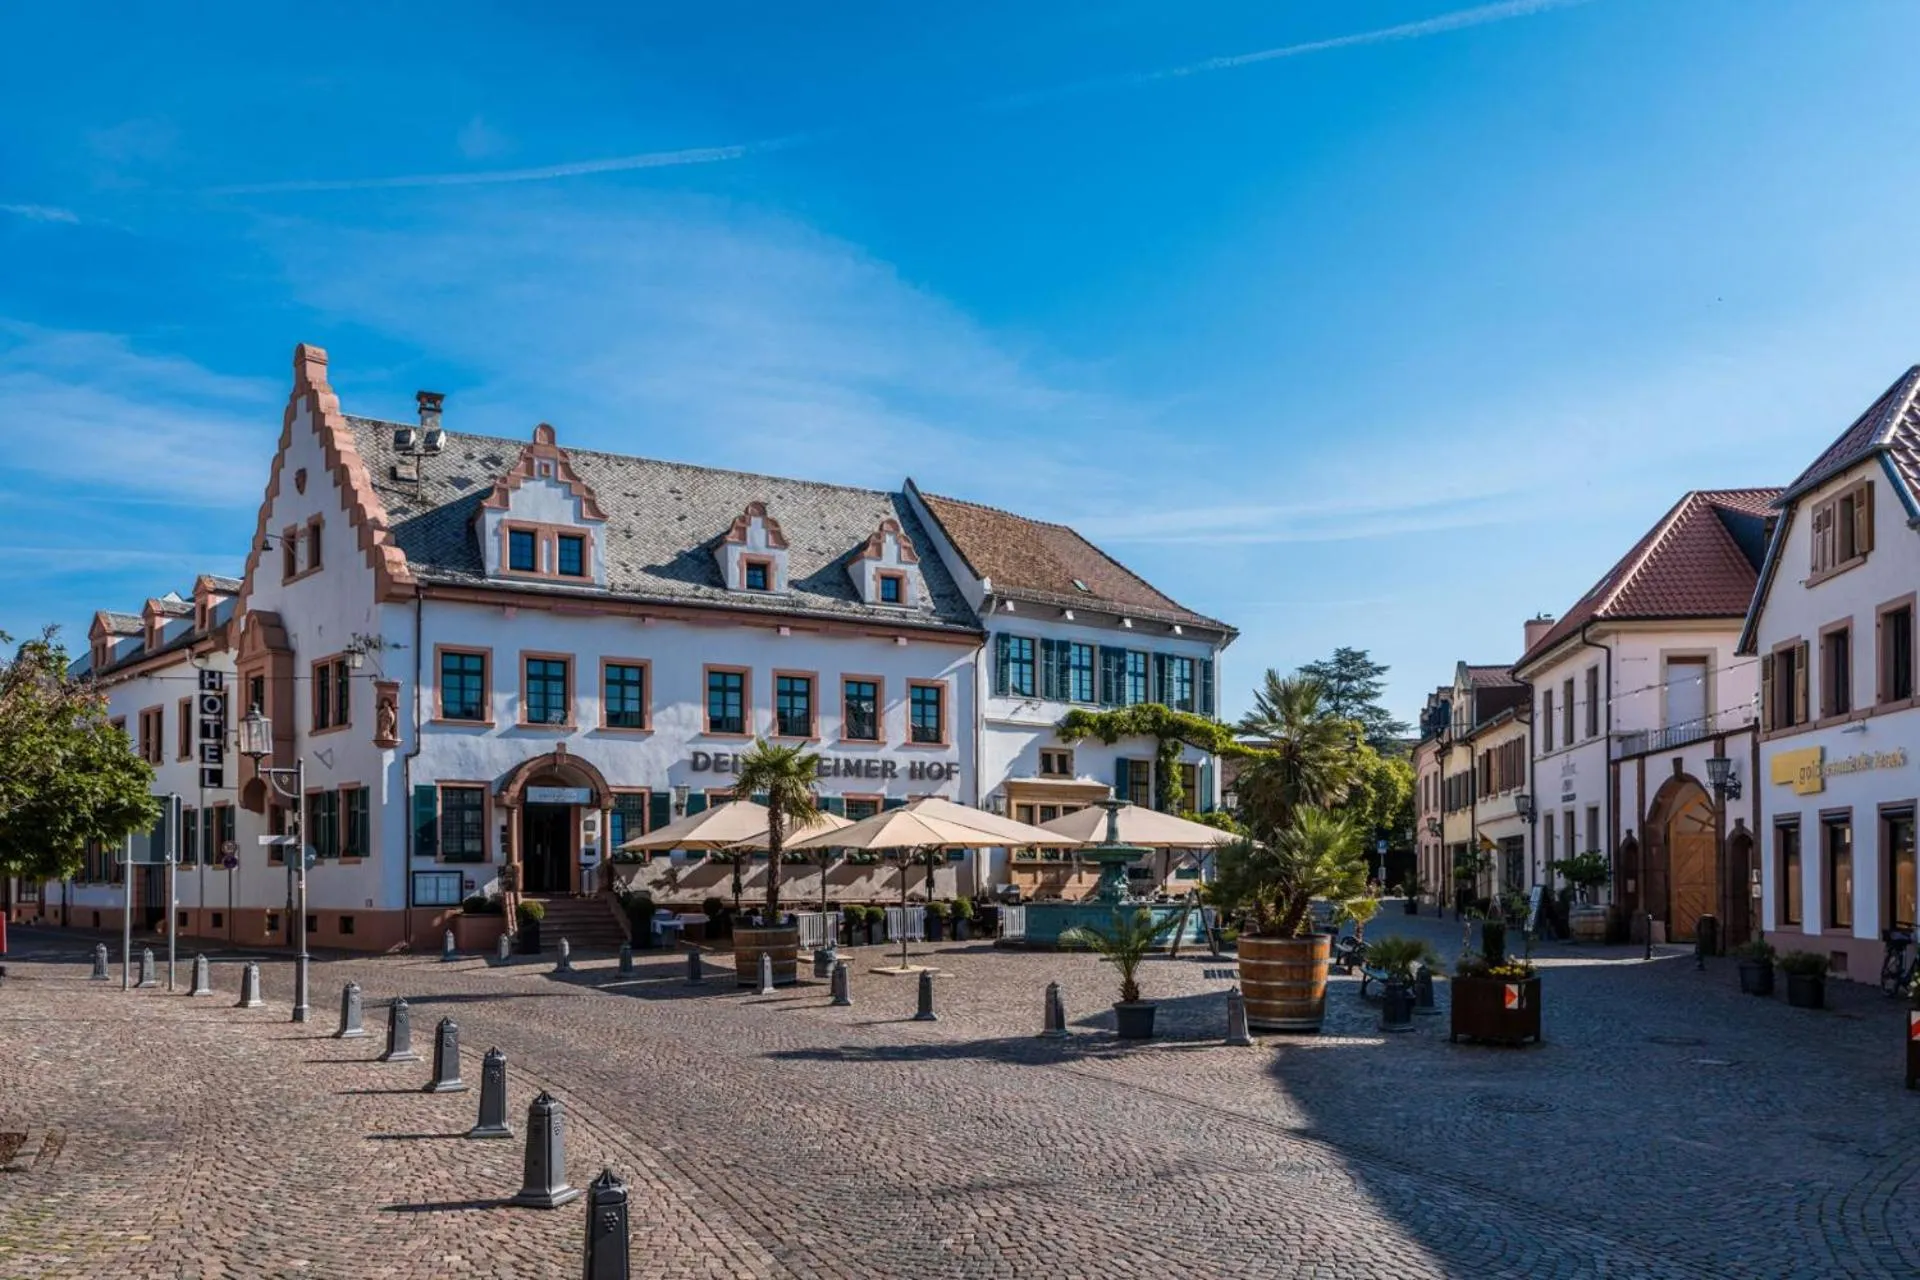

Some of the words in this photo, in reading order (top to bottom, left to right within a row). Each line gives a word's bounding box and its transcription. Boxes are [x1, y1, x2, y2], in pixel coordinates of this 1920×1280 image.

[202, 669, 222, 788] HOTEL
[690, 751, 899, 779] DEIEIMER
[909, 759, 960, 781] HOF
